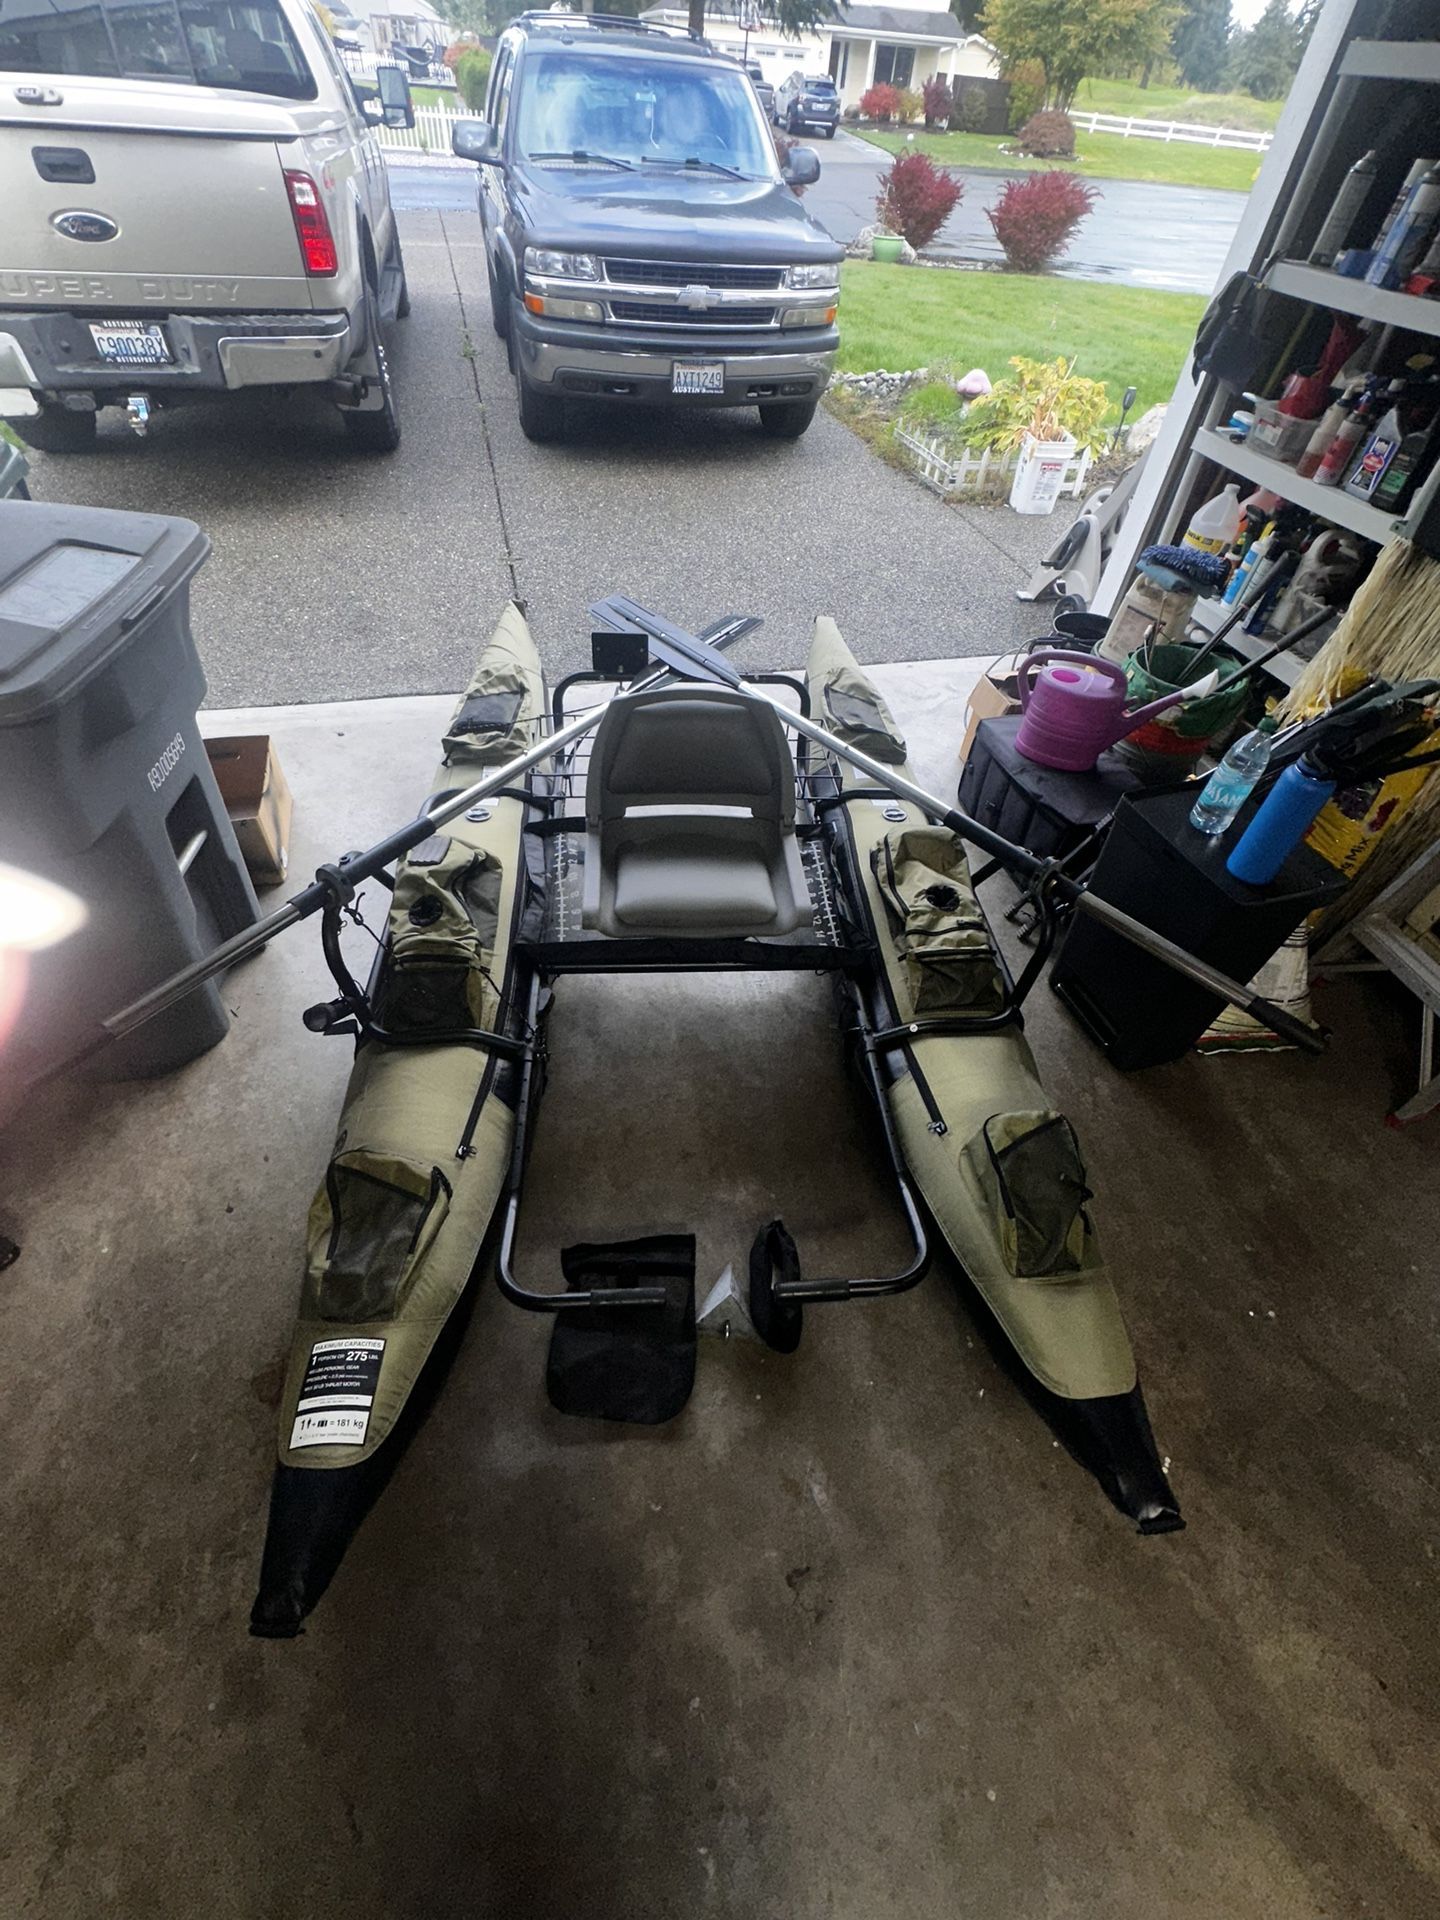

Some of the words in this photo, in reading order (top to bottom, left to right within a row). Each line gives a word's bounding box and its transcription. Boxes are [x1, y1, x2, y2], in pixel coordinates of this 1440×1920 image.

[136, 279, 240, 301] DUTY
[97, 336, 168, 357] C90038X
[1345, 838, 1370, 861] Mix
[311, 1355, 318, 1366] 1
[345, 1351, 369, 1361] 275
[336, 1419, 350, 1427] 181
[353, 1419, 364, 1429] kg
